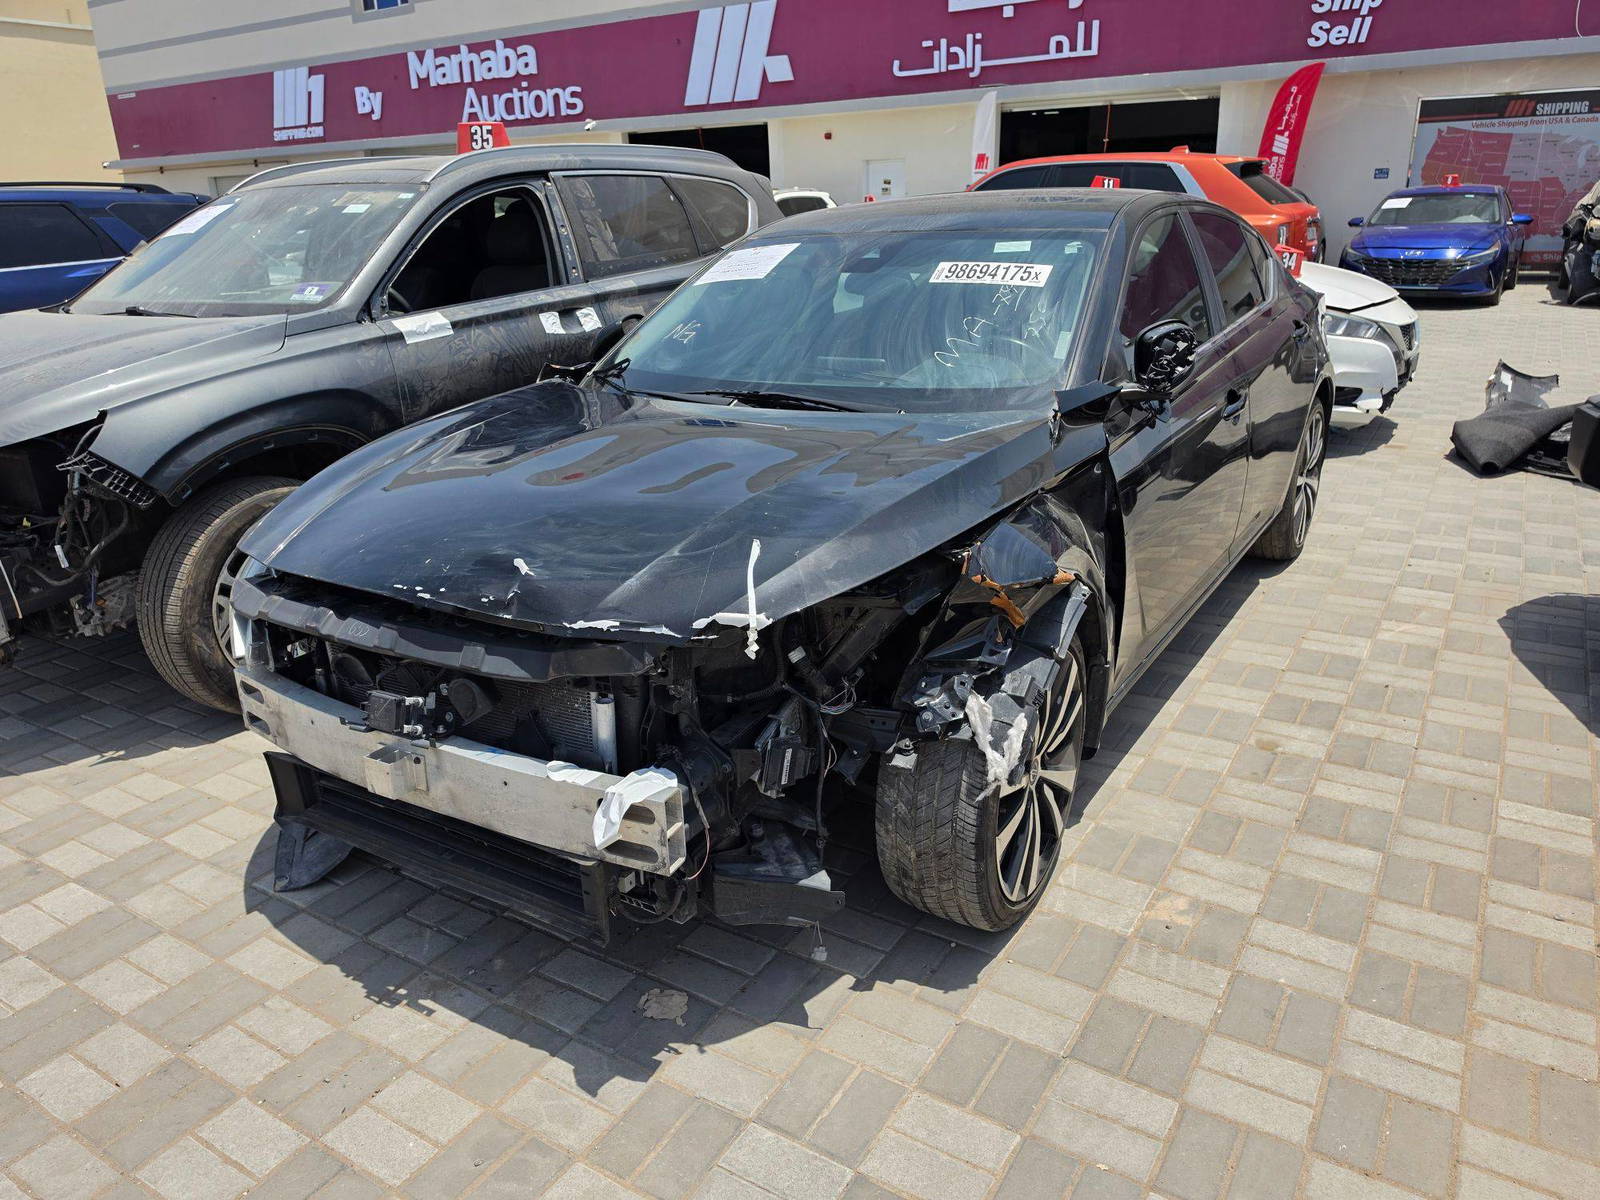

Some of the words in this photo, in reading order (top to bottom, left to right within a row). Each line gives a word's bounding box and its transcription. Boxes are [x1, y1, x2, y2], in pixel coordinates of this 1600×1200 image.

[1307, 16, 1373, 47] Sell
[893, 19, 1100, 78] للمزادات
[407, 39, 538, 89] Marhaba
[354, 86, 382, 120] By
[462, 81, 584, 123] Auctions
[1536, 101, 1589, 116] SHIPPING
[1472, 120, 1496, 129] Vehicle
[1497, 119, 1528, 128] Shipping
[1529, 118, 1548, 126] from
[1572, 116, 1599, 124] Canada
[470, 125, 493, 150] 35
[1103, 178, 1114, 189] 11
[1282, 252, 1297, 270] 34
